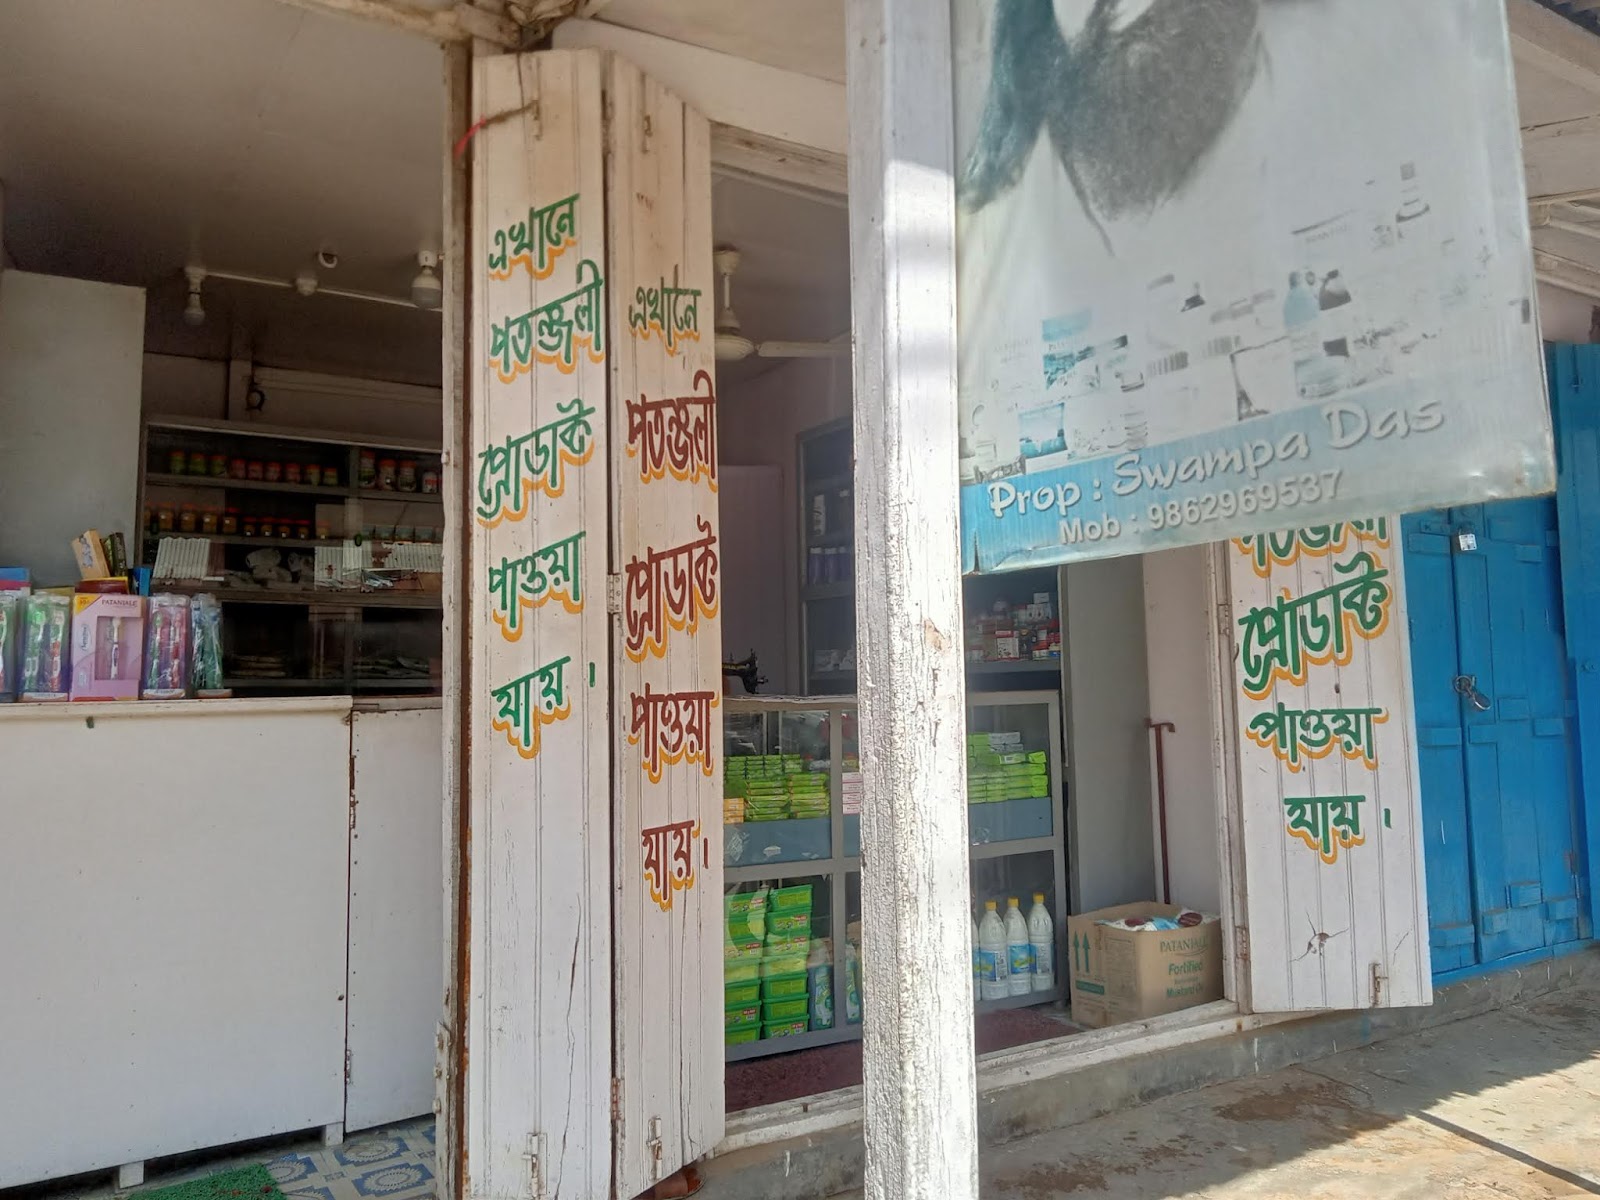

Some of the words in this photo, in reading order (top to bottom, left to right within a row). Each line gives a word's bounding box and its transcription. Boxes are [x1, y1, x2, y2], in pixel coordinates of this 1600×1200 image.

[488, 193, 581, 270] এখানে
[628, 264, 702, 348] এখানে
[986, 480, 1082, 519] Prop
[1111, 431, 1311, 497] Swampa
[1321, 400, 1447, 451] Das
[1057, 511, 1123, 545] Mob
[1148, 467, 1345, 531] 9862969537
[488, 530, 586, 630] পাওয়া
[630, 682, 716, 775] পাওয়া
[1249, 702, 1383, 764] পাওয়া
